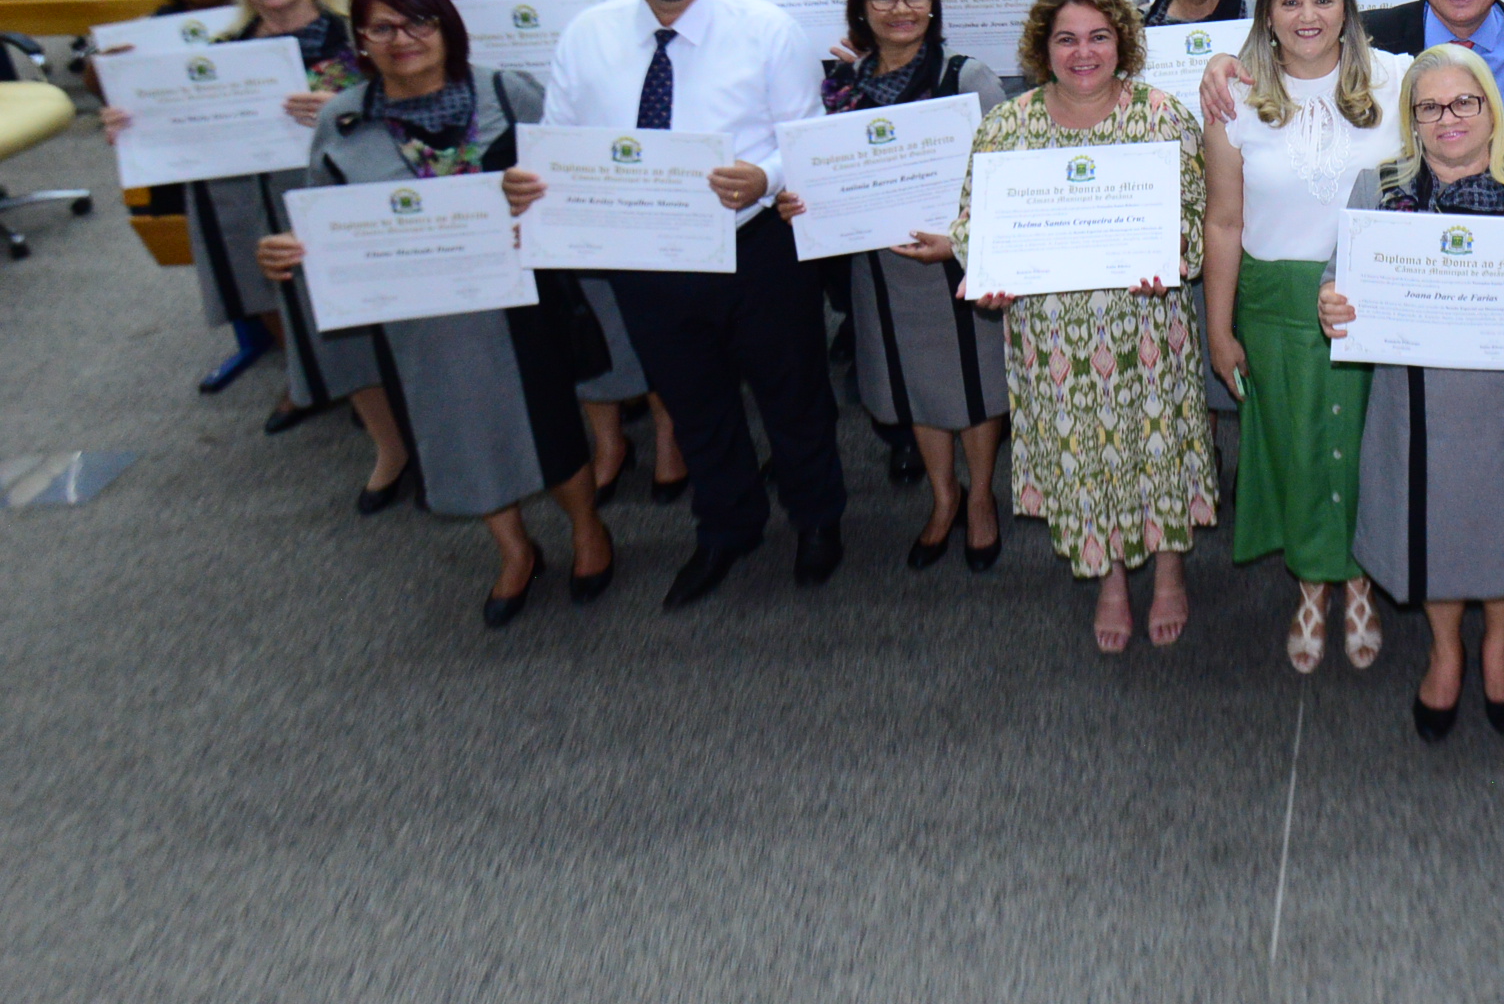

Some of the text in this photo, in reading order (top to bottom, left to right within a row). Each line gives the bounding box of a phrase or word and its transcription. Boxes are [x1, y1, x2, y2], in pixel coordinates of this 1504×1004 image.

[811, 154, 854, 166] Diploma
[858, 151, 868, 159] de
[872, 146, 903, 157] Honra
[921, 136, 955, 148] Mérito
[550, 162, 704, 177] Diploma de Honra ao Mérito
[900, 172, 938, 183] Rodrigues
[1007, 188, 1050, 198] Diploma
[1069, 185, 1100, 194] Honra
[1104, 184, 1115, 192] ao
[1120, 182, 1154, 191] Mérito
[1073, 218, 1112, 226] Cerqueira
[1373, 253, 1421, 266] Diploma
[1426, 257, 1437, 266] de
[1442, 256, 1478, 268] Honra
[1481, 260, 1494, 268] ao
[1395, 266, 1426, 274] Câmara
[1428, 267, 1469, 277] Municipal
[1405, 291, 1431, 299] Joana
